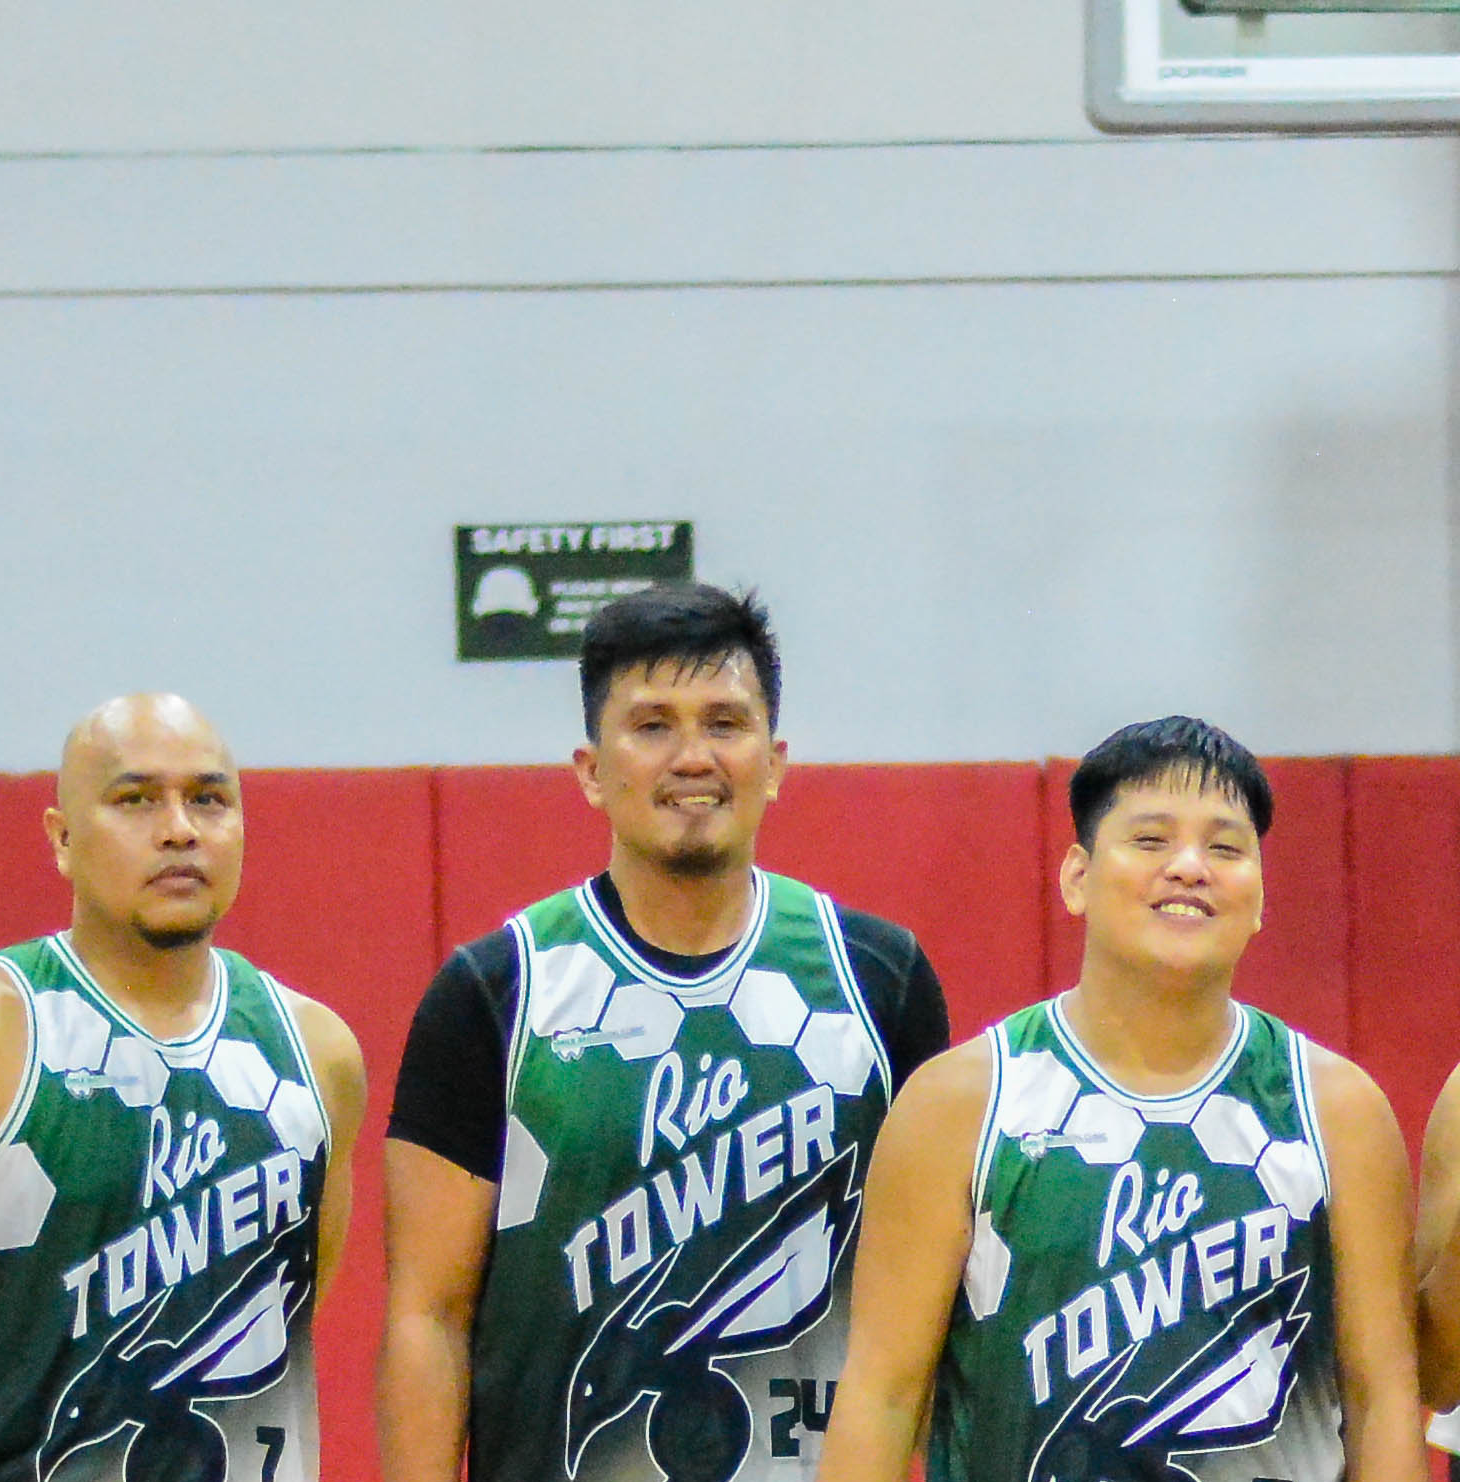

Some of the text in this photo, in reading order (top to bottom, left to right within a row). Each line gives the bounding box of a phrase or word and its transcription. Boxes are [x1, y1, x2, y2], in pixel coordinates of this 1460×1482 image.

[472, 525, 676, 554] SAFETY FIRST
[143, 1106, 226, 1208] Rio
[641, 1052, 748, 1167] Rio
[63, 1150, 302, 1339] TOWER
[564, 1085, 835, 1313] TOWER
[1099, 1161, 1203, 1267] Rio
[1023, 1206, 1288, 1404] TOWER
[769, 1377, 835, 1458] 24
